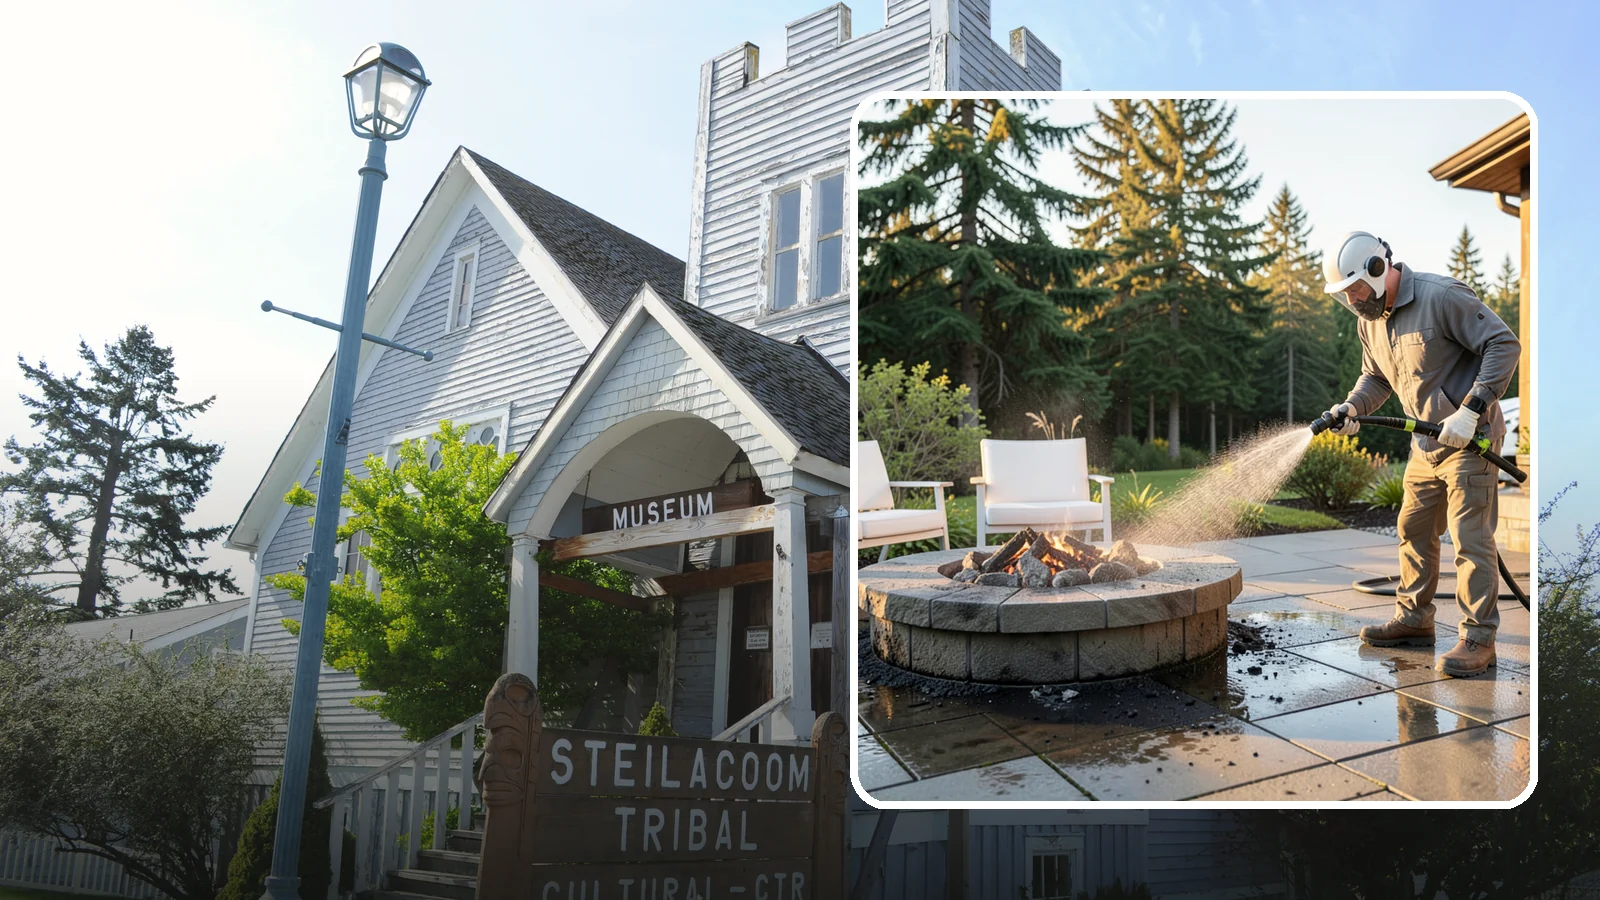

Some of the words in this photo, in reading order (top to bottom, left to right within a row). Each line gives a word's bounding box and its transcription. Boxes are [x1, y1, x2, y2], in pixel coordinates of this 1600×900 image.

[613, 491, 714, 531] MUSEUM
[550, 738, 810, 793] STEILACOOM
[614, 806, 758, 852] TRIBAL
